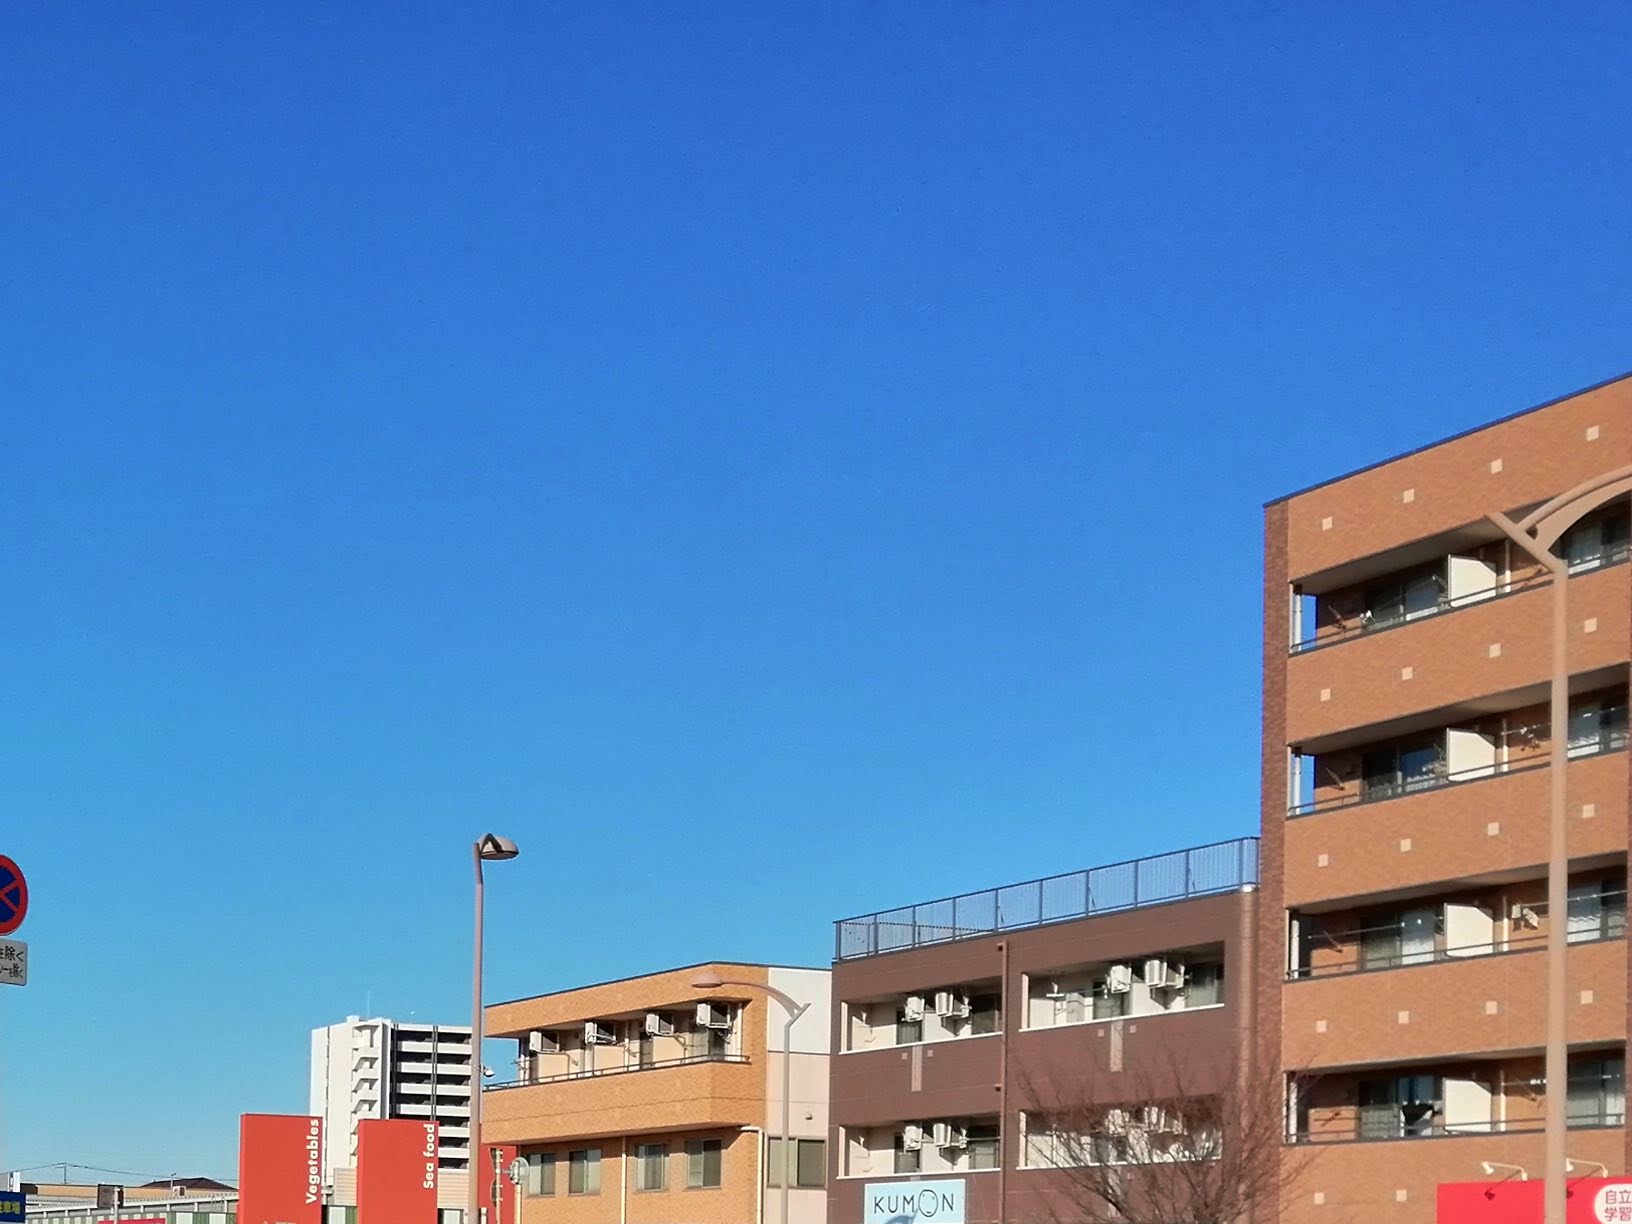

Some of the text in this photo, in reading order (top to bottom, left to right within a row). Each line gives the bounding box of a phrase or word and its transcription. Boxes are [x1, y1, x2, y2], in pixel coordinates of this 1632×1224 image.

[306, 1119, 319, 1204] Vegetables
[423, 1124, 435, 1189] Sea food
[874, 1189, 955, 1218] KUMON
